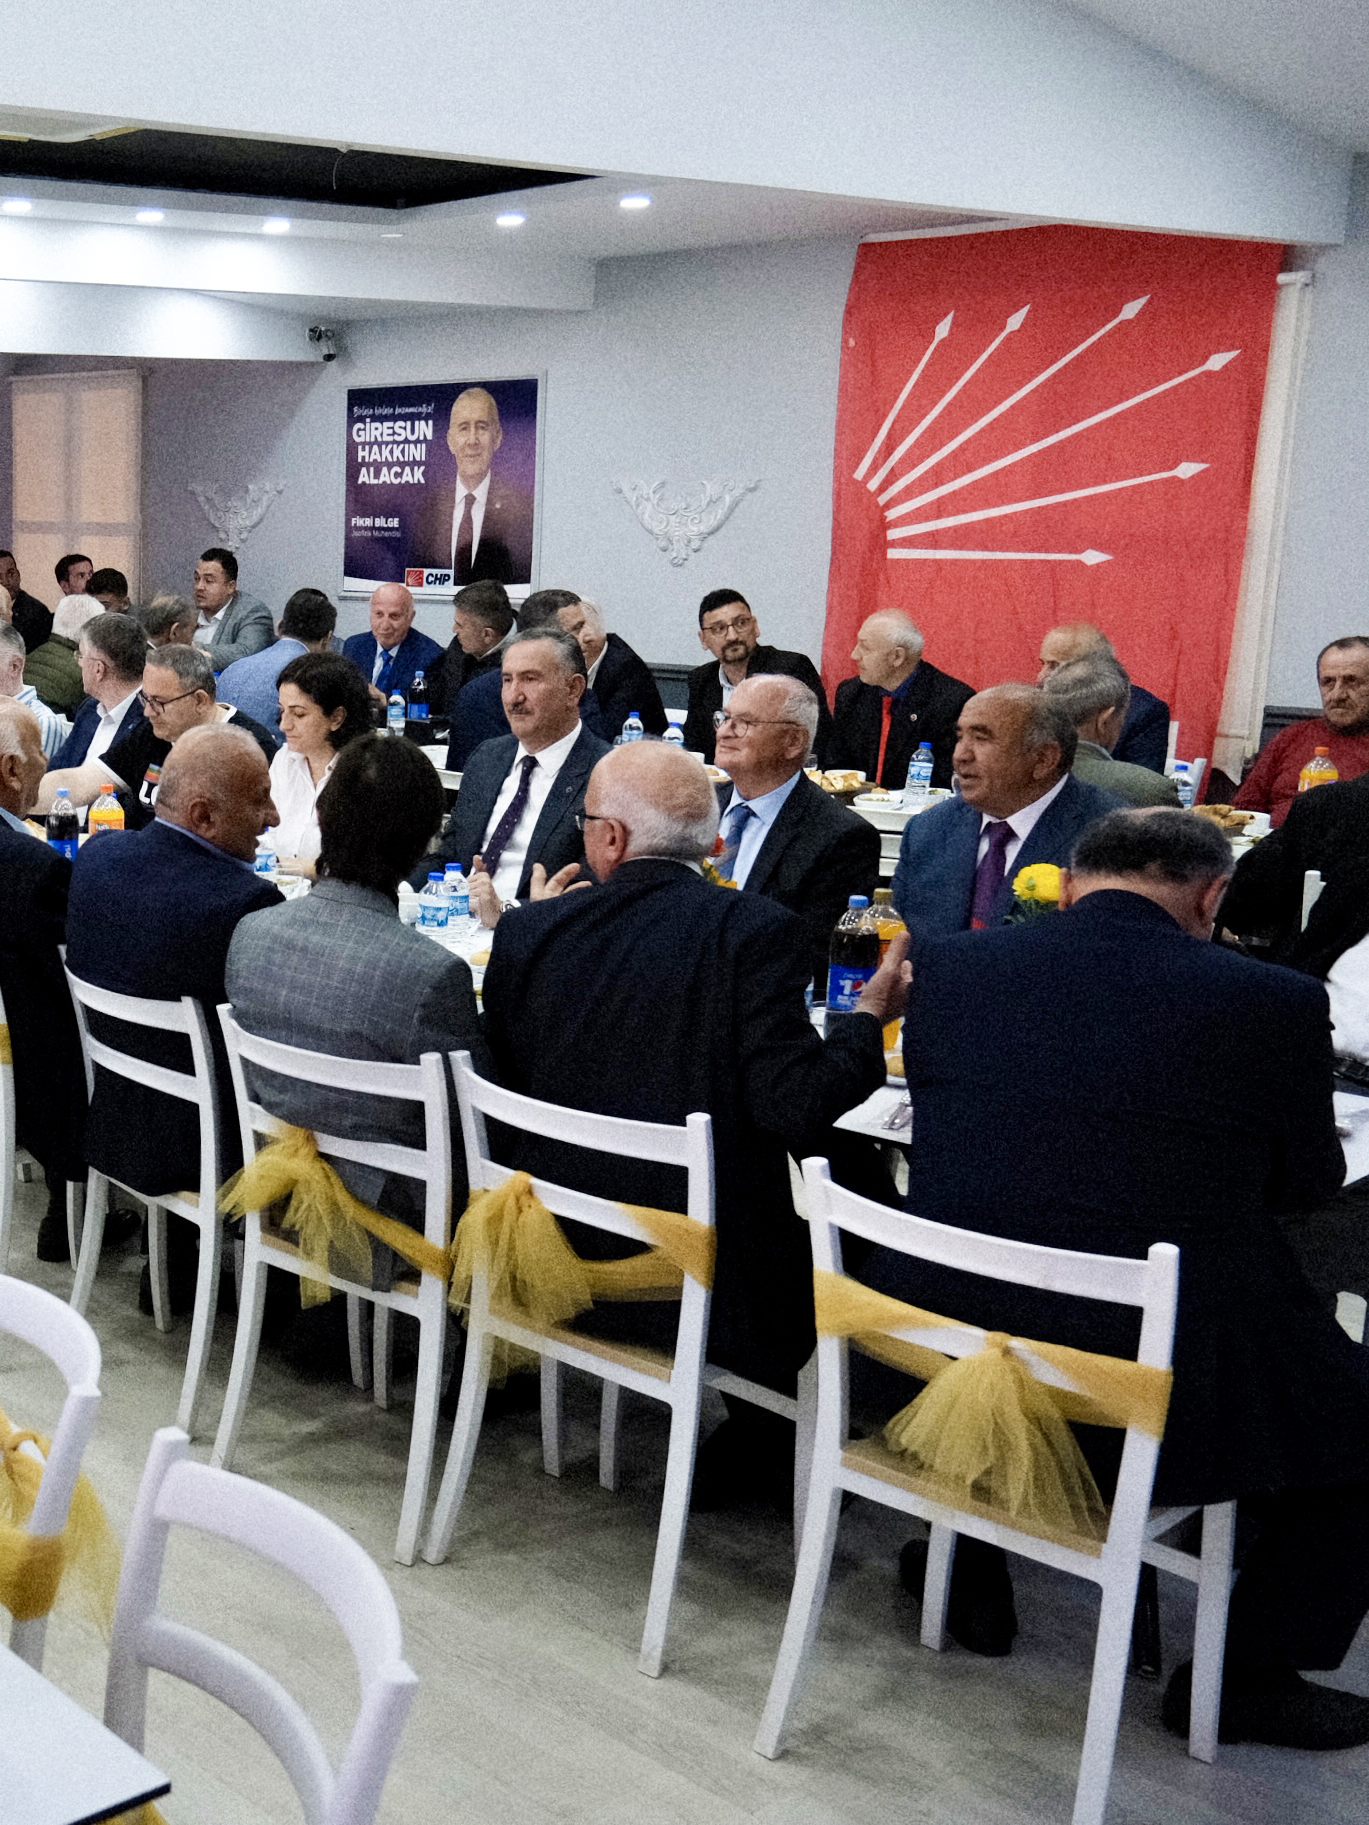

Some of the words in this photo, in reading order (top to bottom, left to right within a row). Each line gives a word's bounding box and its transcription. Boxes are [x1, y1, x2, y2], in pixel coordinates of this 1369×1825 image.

[352, 418, 434, 442] GİRESUN
[357, 443, 426, 462] HAKKINI
[357, 465, 426, 484] ALACAK
[351, 516, 373, 527] FİKRİ
[374, 516, 400, 527] BİLGE
[425, 573, 451, 585] CHP
